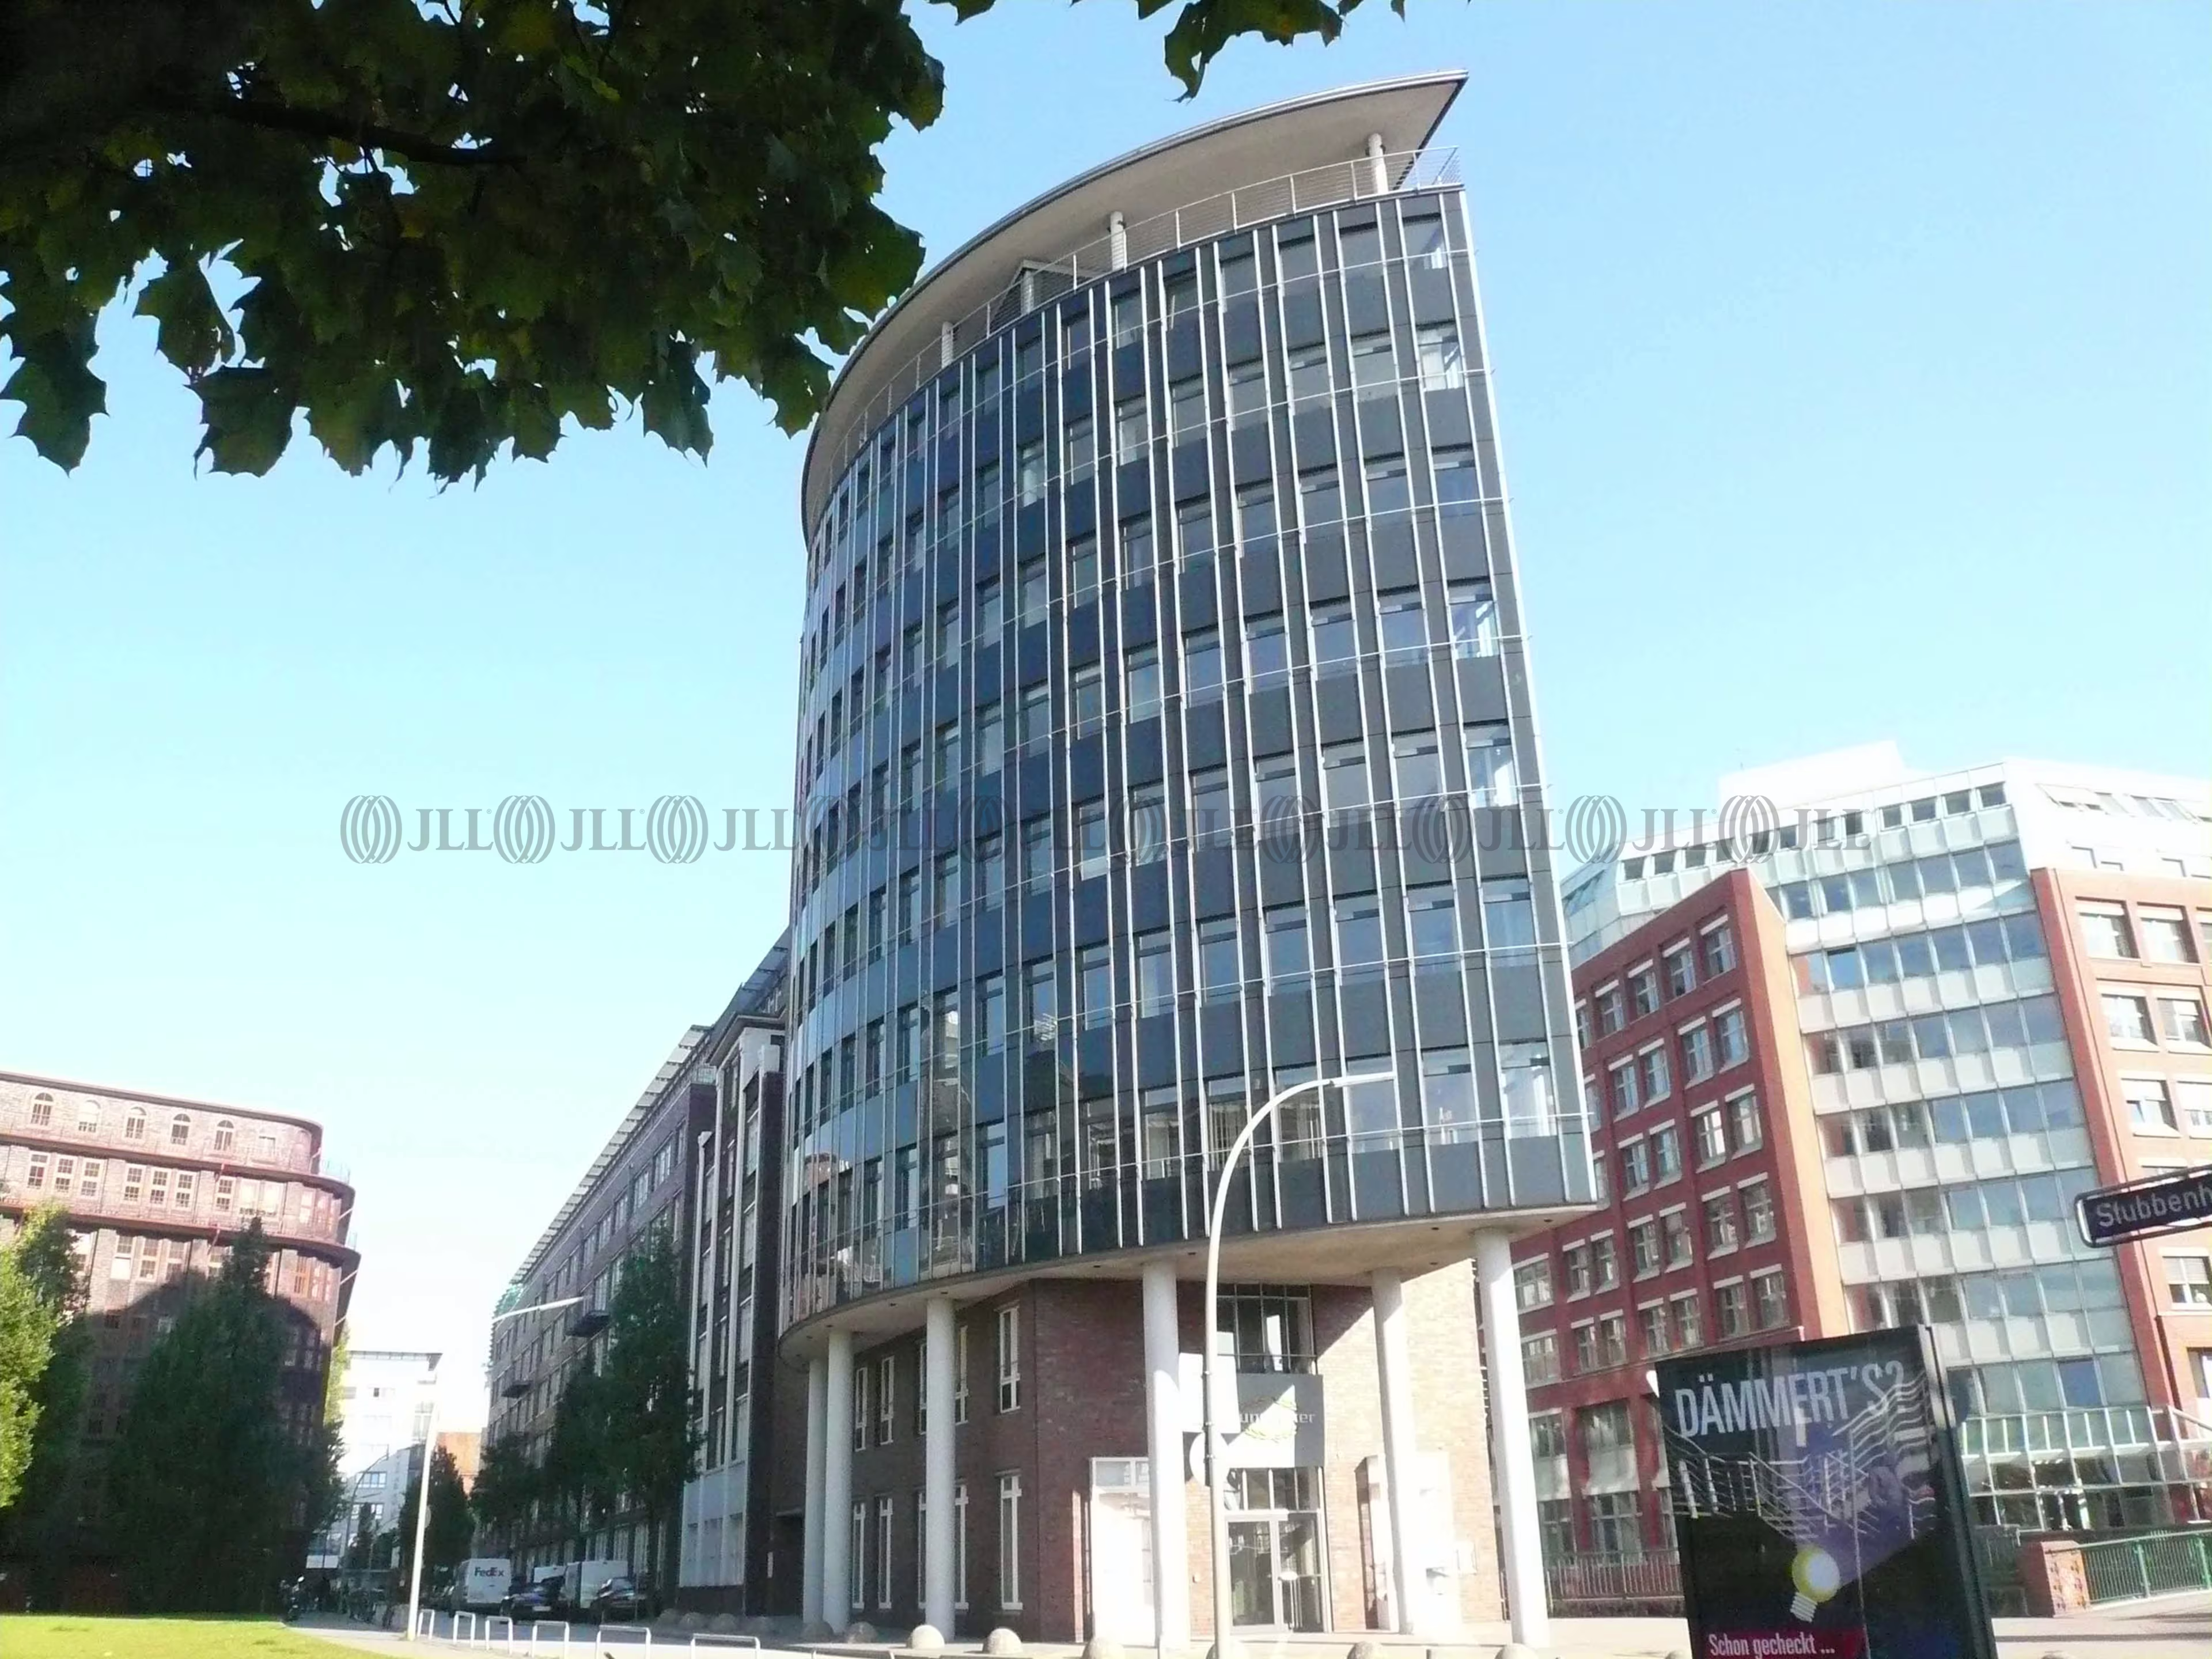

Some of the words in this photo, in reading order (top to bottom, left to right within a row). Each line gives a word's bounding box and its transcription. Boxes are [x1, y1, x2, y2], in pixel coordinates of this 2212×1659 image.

[474, 1566, 505, 1577] FedEx
[1709, 1633, 1749, 1657] Schon
[1753, 1631, 1816, 1659] gecheckt
